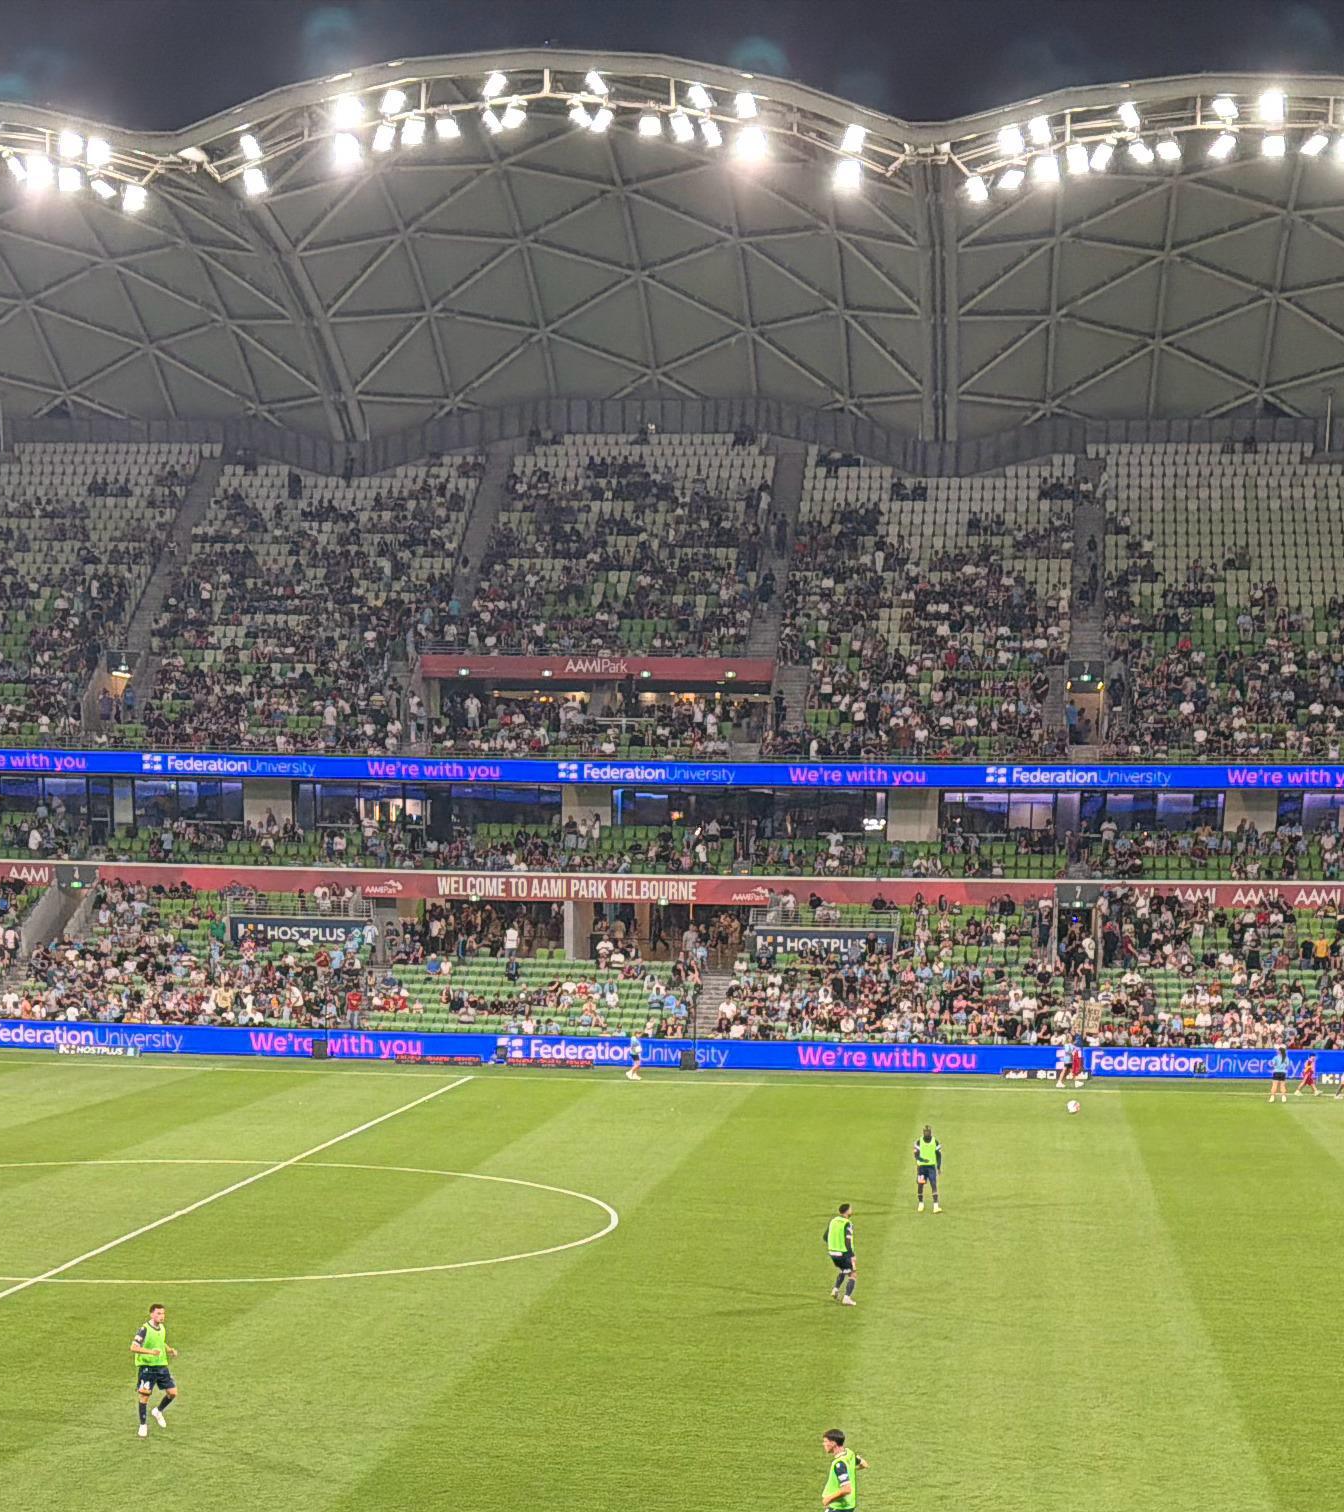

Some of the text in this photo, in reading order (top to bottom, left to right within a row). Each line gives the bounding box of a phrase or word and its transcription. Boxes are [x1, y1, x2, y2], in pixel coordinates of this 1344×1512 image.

[11, 751, 51, 768] with
[55, 756, 86, 772] you
[367, 760, 500, 782] We're with you
[789, 766, 926, 786] We're with you
[1227, 768, 1283, 784] We're
[1287, 768, 1331, 785] with
[9, 867, 48, 883] AAMI
[437, 876, 698, 900] WELCOME TO AAMI PARK MELBOURNE
[1294, 888, 1342, 905] AAMI
[379, 1039, 422, 1059] you
[797, 1045, 978, 1074] We're with you
